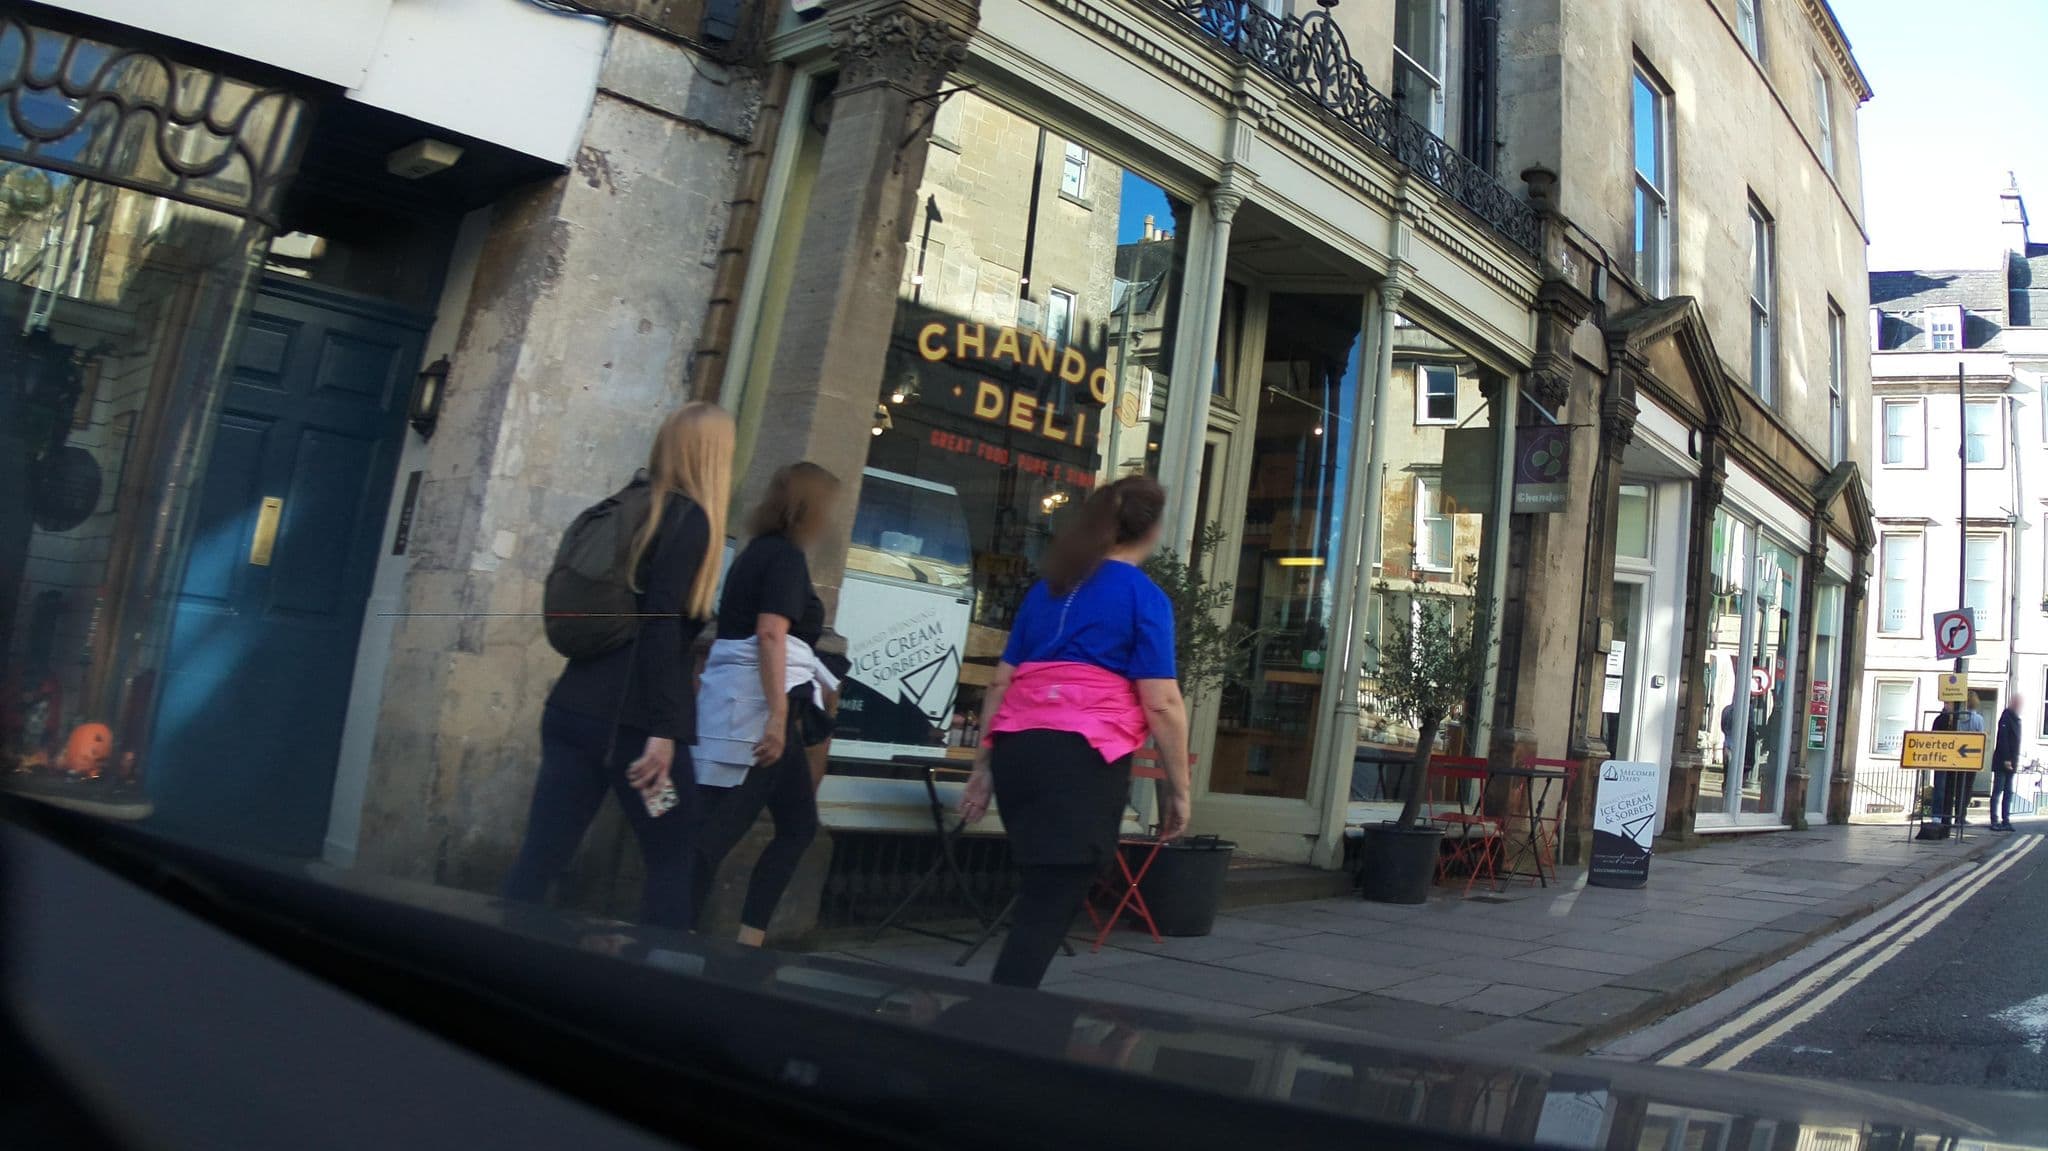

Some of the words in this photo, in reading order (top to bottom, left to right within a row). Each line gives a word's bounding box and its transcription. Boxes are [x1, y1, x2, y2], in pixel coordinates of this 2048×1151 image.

[918, 323, 1139, 428] CHANDOS
[974, 380, 1086, 447] DELI
[853, 649, 881, 675] ICE
[885, 621, 944, 658] CREAM
[872, 646, 931, 686] SORBETS
[1908, 738, 1955, 750] Diverted
[1912, 751, 1947, 762] traffic
[1600, 805, 1616, 816] ICE
[1618, 794, 1651, 810] CREAM
[1615, 802, 1654, 821] SORBETS
